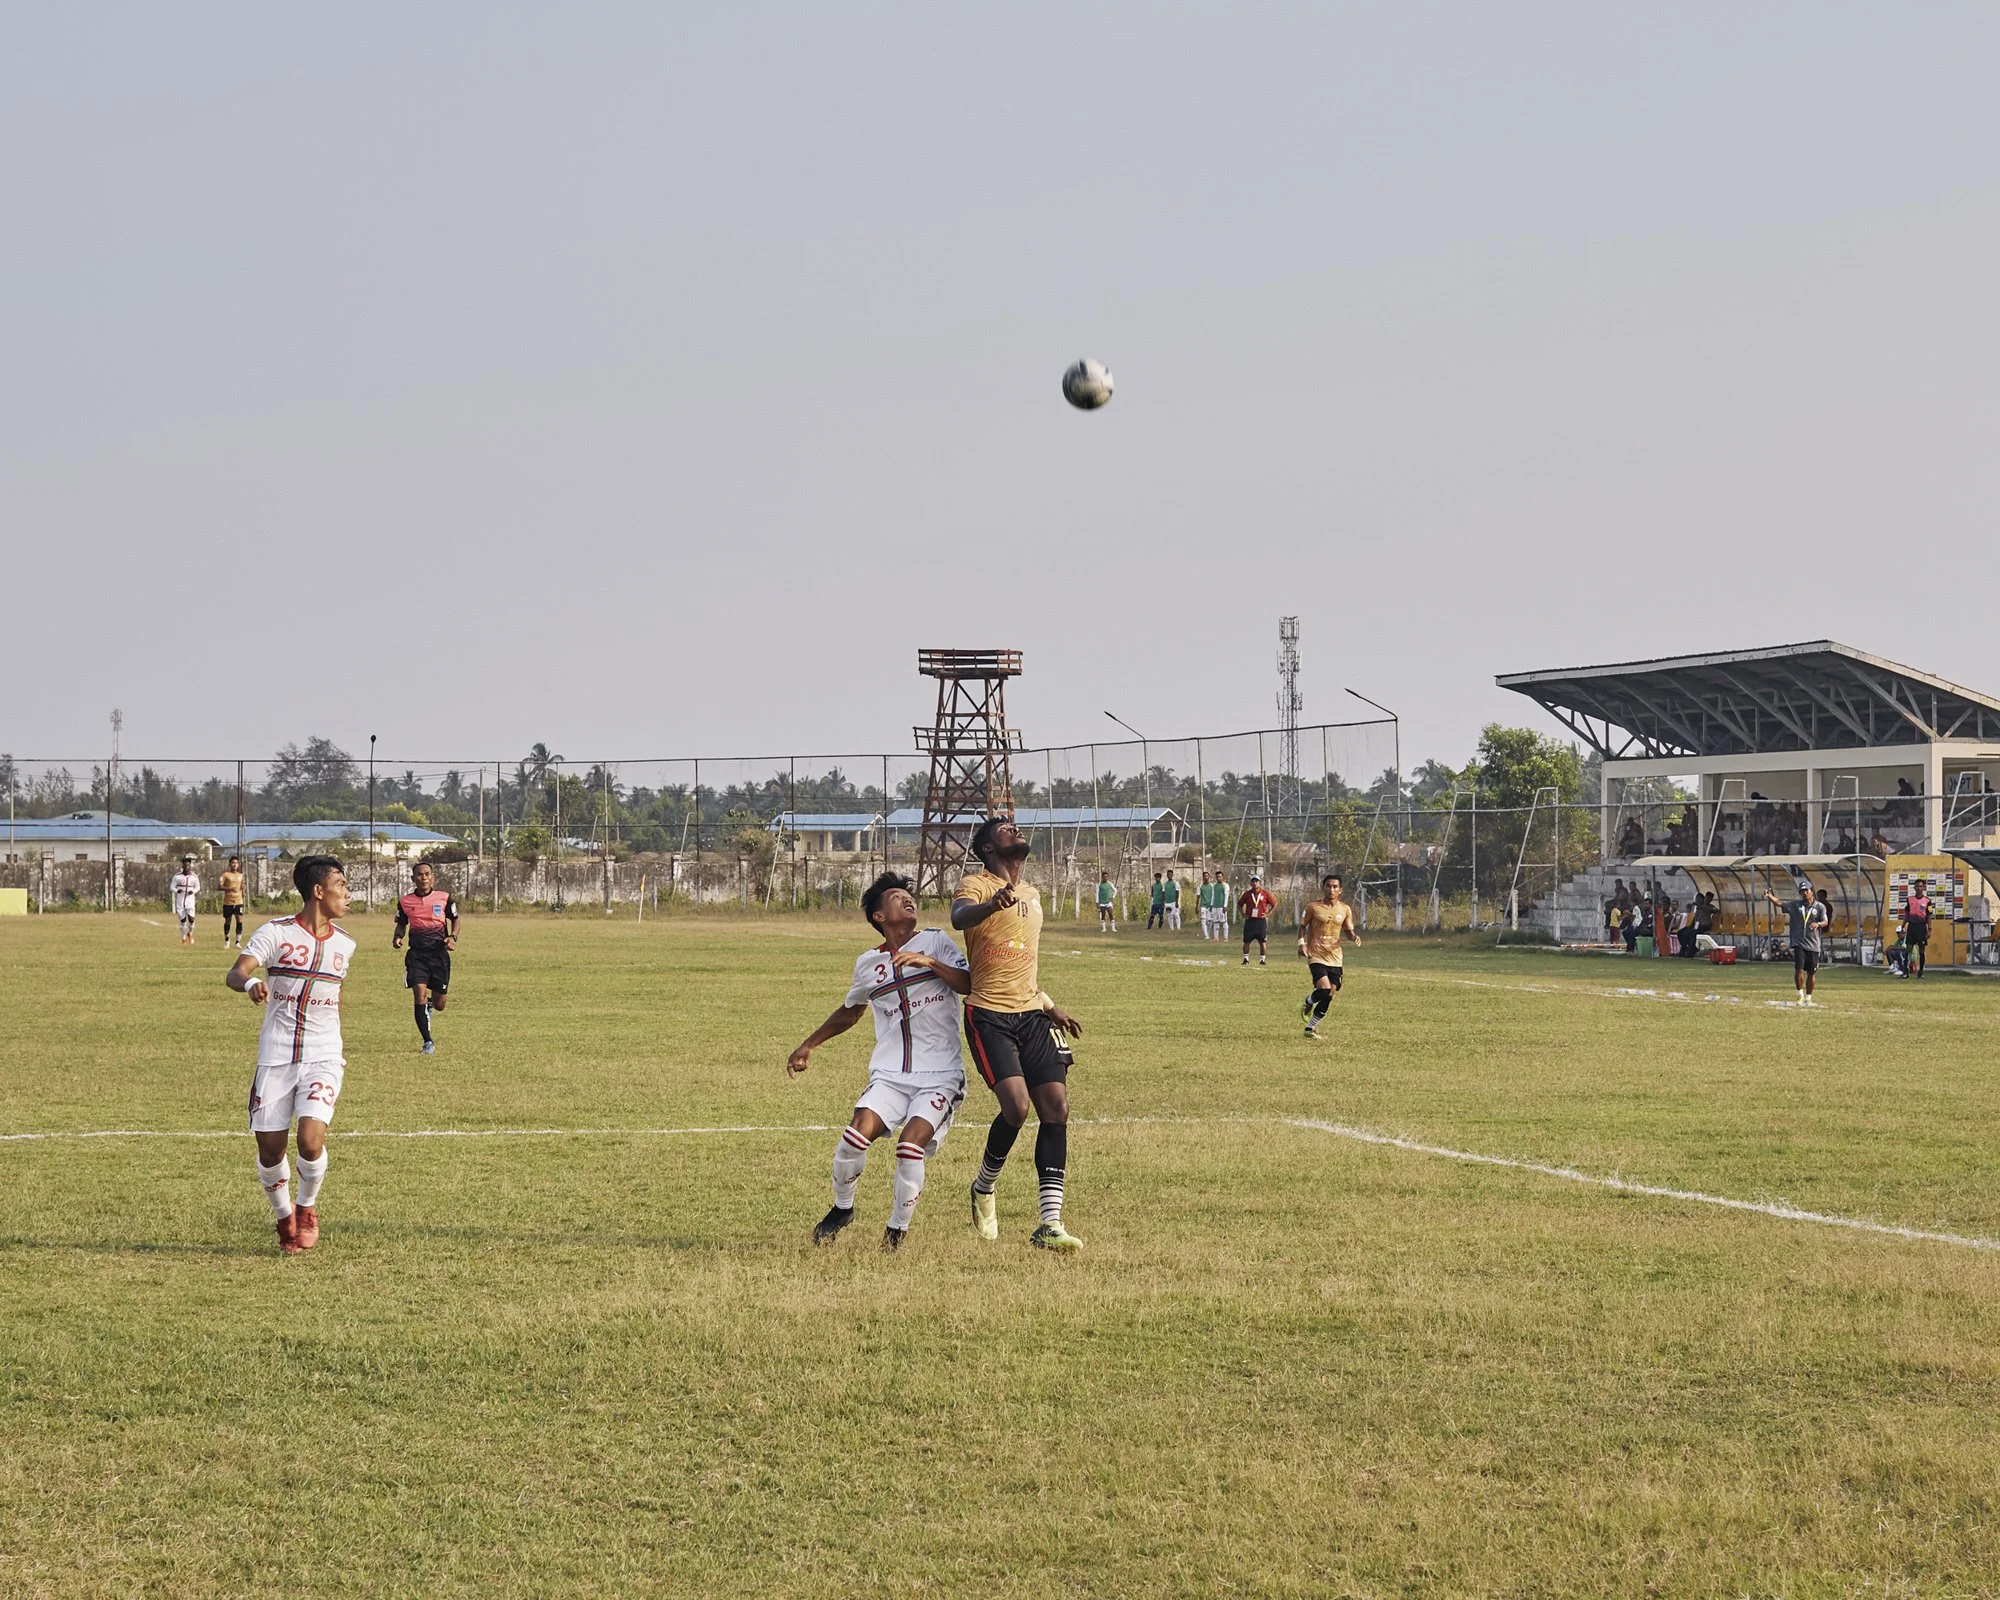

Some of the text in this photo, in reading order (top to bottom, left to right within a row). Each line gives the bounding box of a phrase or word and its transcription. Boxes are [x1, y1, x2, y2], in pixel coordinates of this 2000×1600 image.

[1017, 902, 1028, 918] 10
[278, 942, 310, 967] 23
[984, 946, 1018, 959] Golden
[874, 963, 888, 984] 3
[306, 995, 323, 1006] For
[1049, 1028, 1069, 1048] 10
[306, 1081, 336, 1107] 23
[929, 1091, 947, 1111] 3
